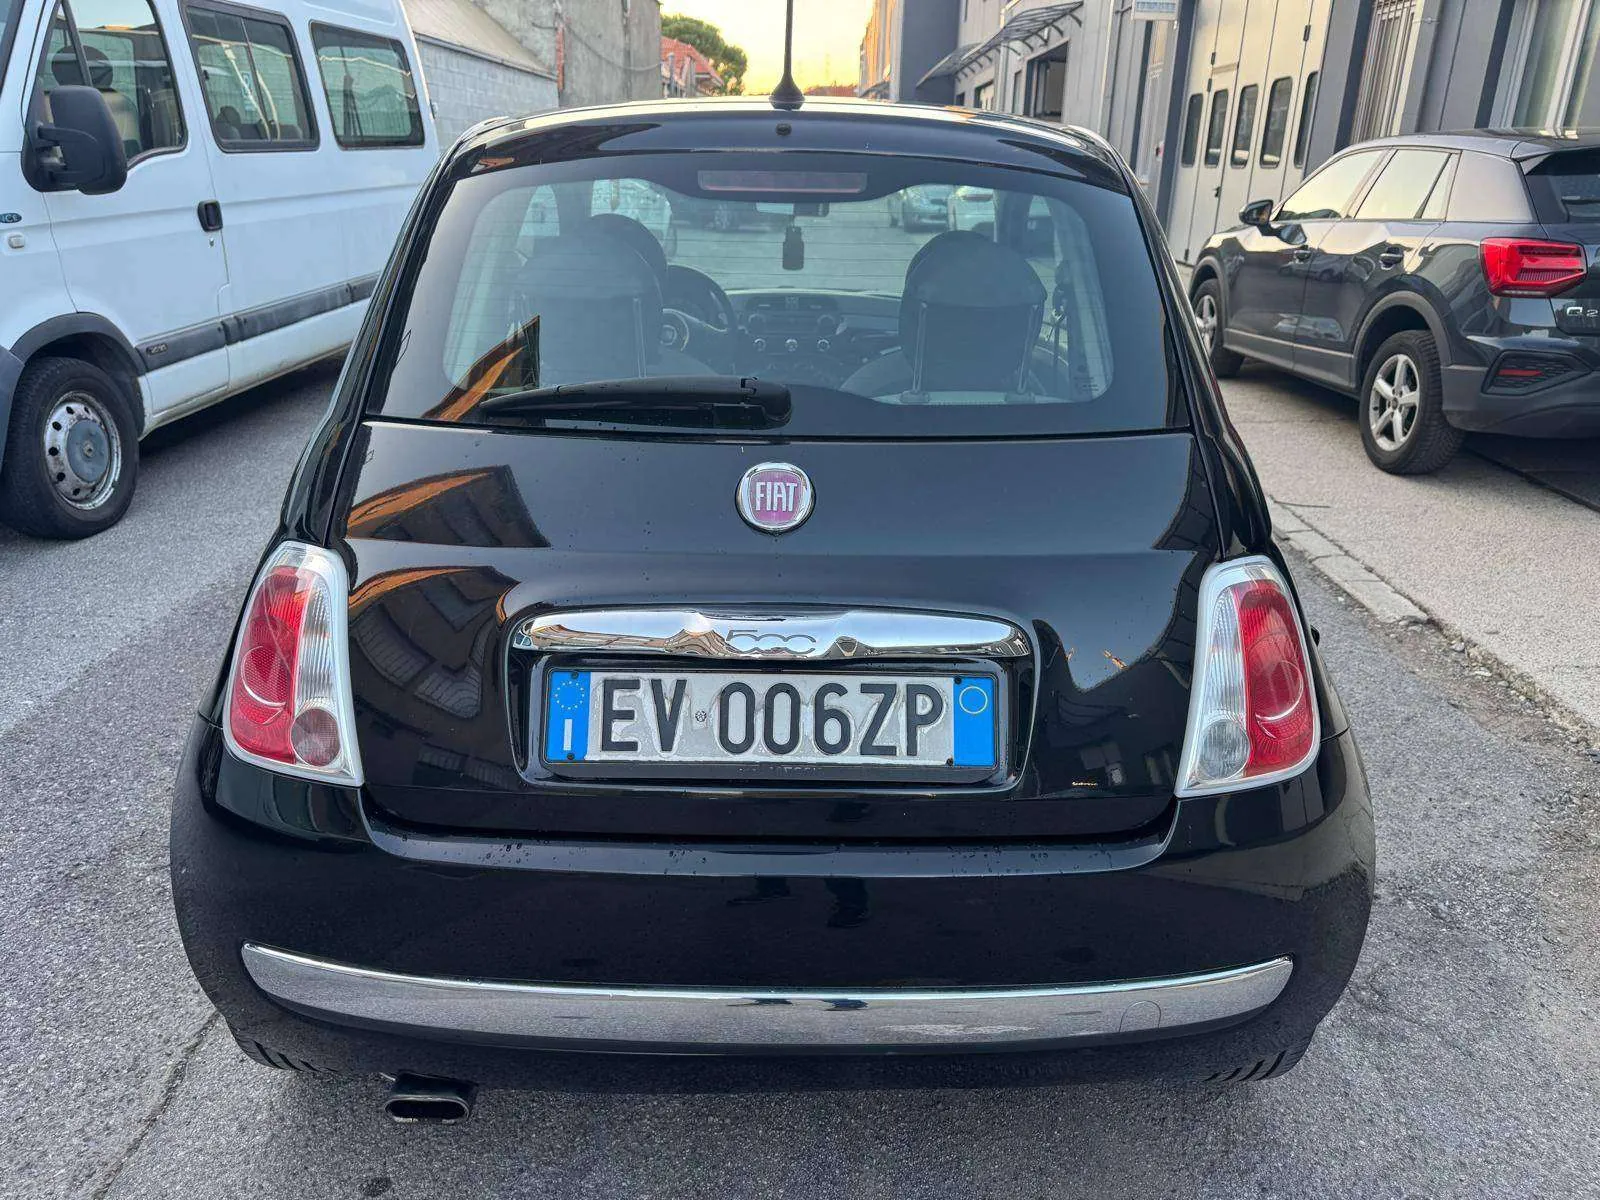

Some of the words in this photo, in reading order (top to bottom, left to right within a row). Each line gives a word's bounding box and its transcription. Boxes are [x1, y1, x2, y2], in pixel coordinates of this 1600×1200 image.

[755, 481, 798, 512] FIAT
[602, 679, 688, 752] EV
[719, 681, 944, 756] 006ZP
